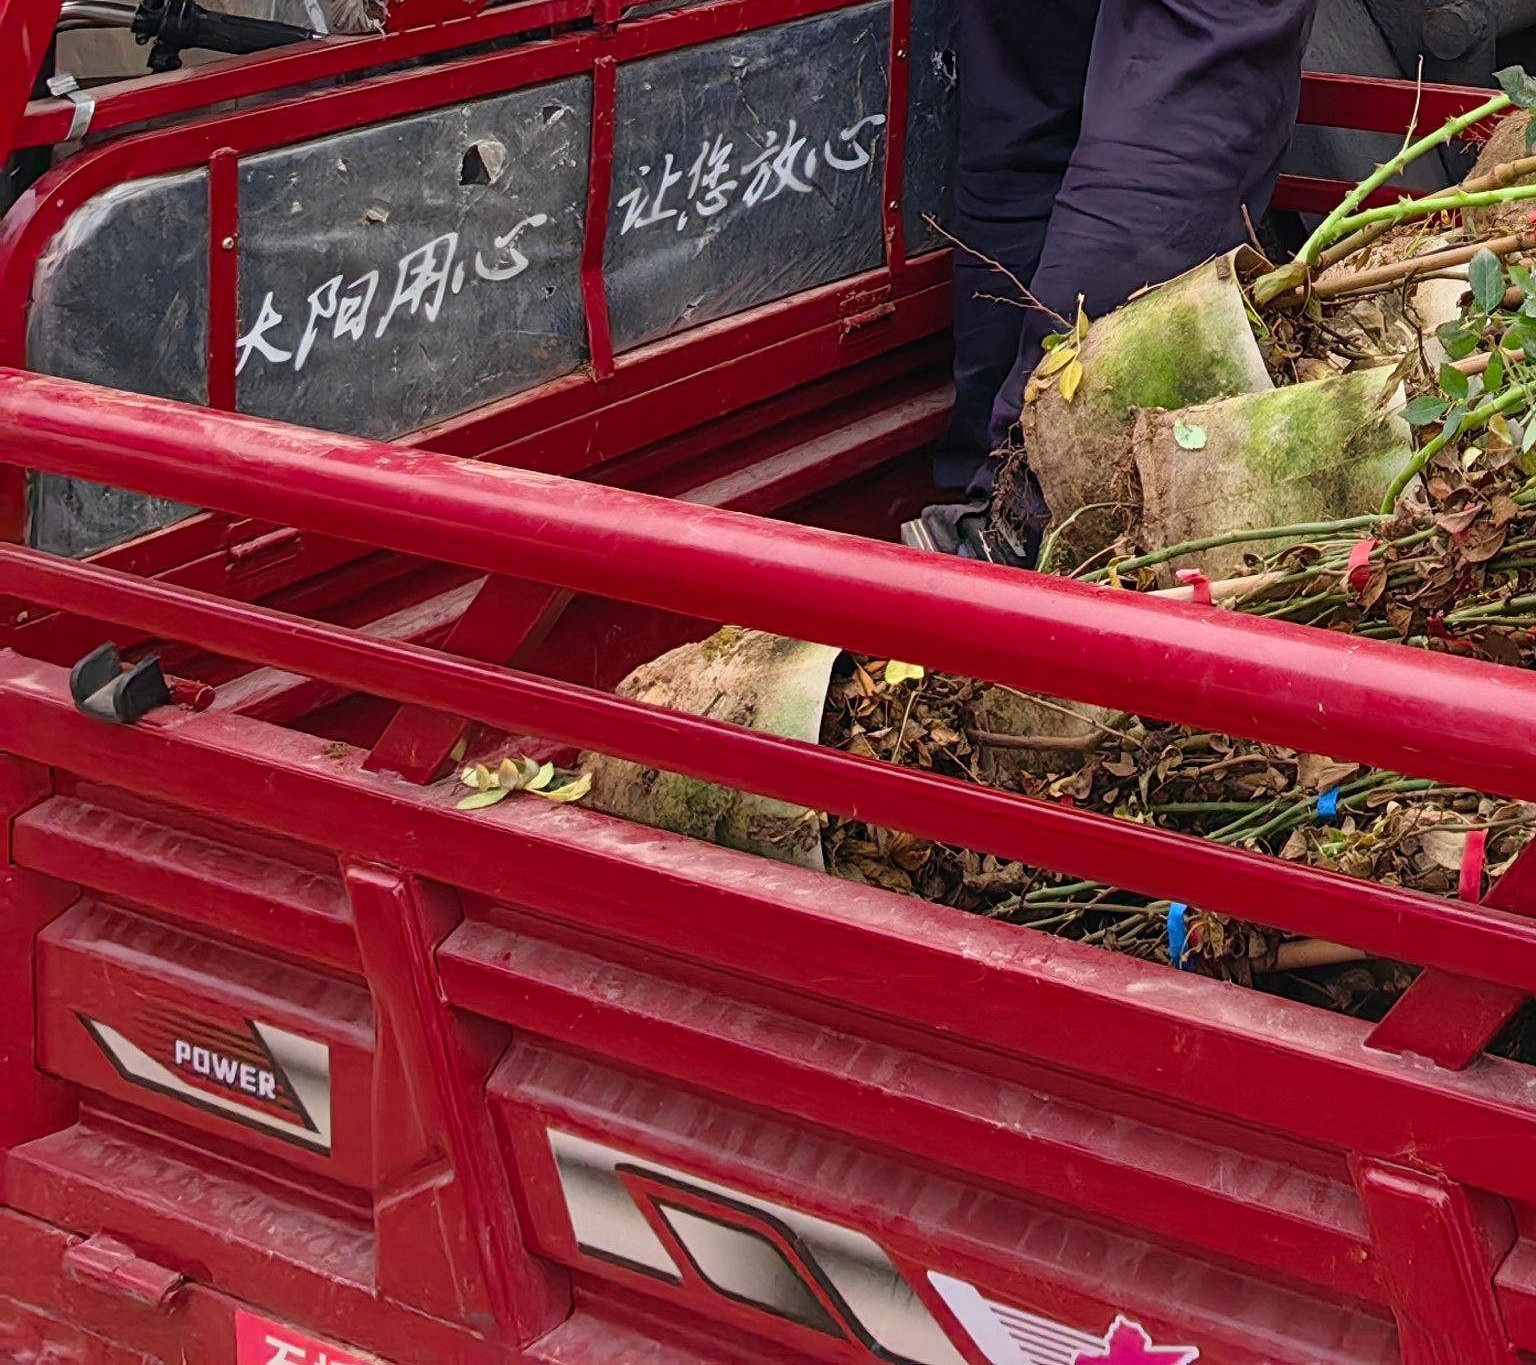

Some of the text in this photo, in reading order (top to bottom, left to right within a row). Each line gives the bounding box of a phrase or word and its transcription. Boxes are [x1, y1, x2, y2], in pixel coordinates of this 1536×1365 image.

[616, 113, 886, 235] 让您放心
[235, 213, 548, 376] 大阳用心
[175, 1038, 276, 1100] POWER
